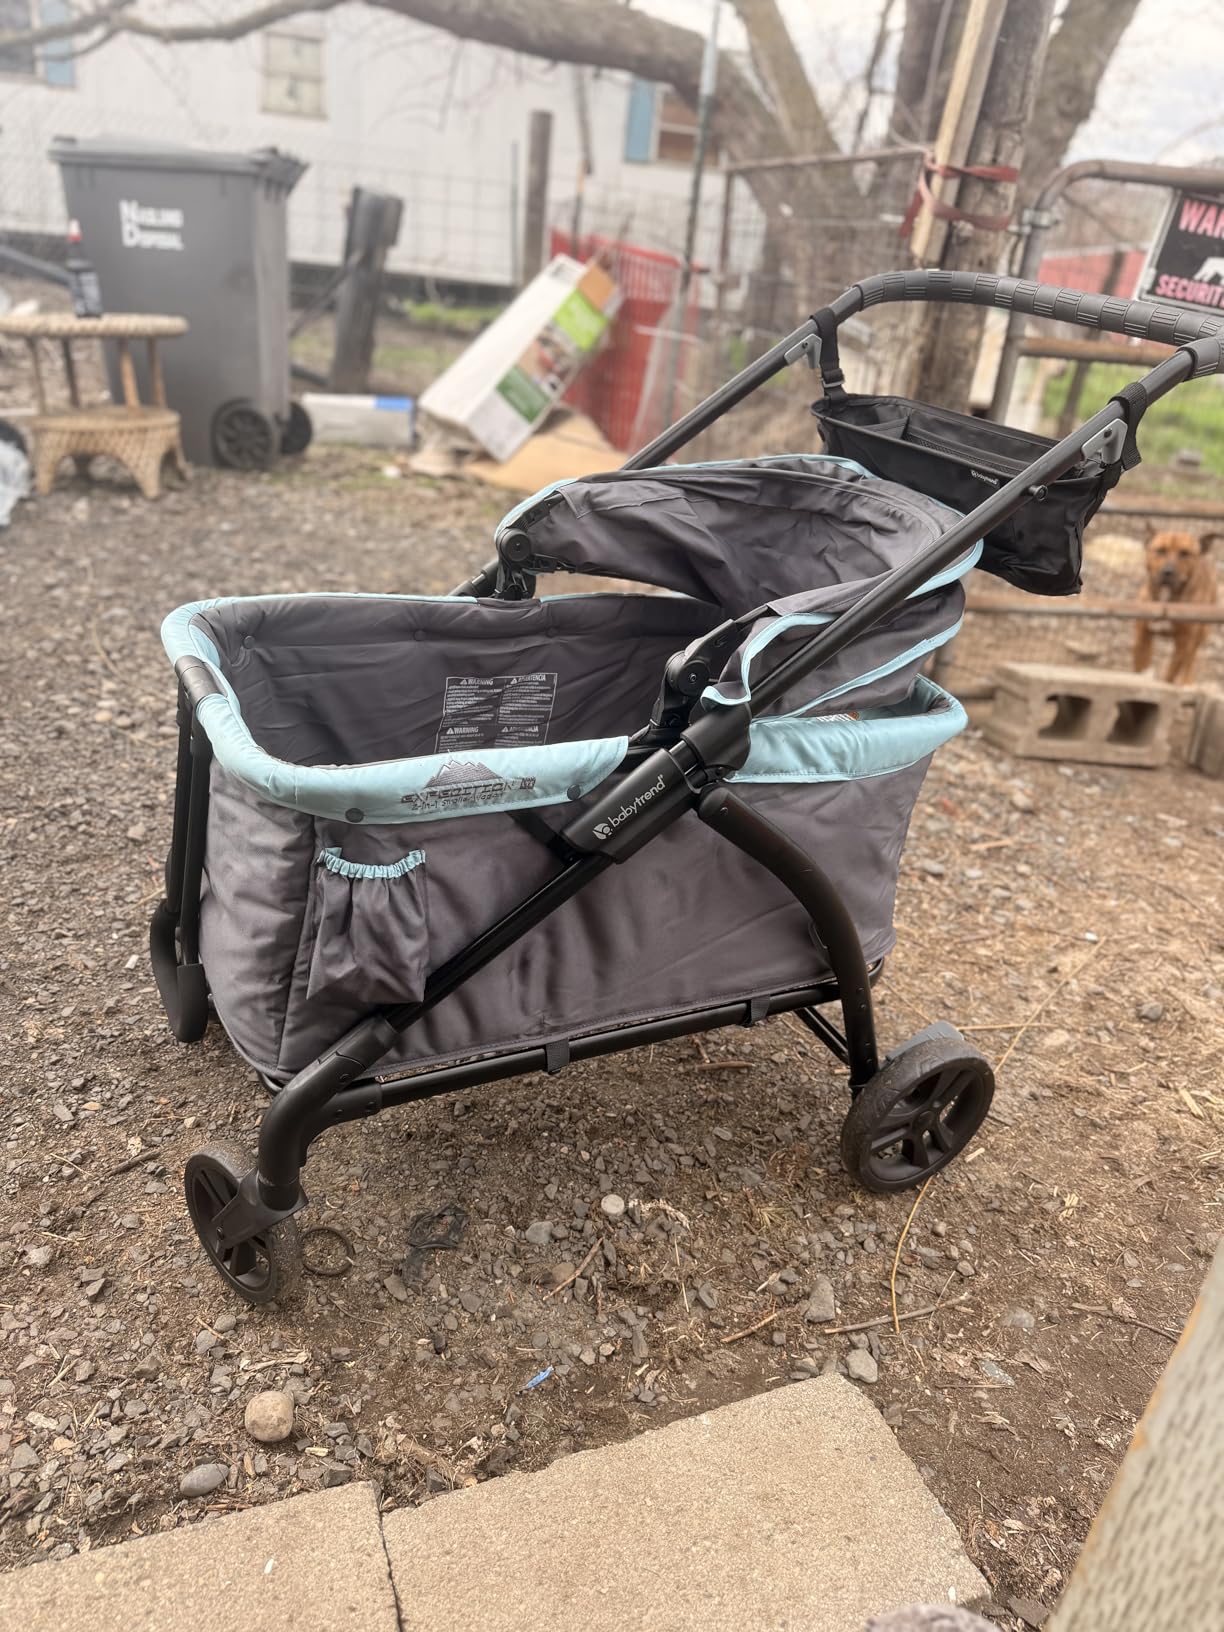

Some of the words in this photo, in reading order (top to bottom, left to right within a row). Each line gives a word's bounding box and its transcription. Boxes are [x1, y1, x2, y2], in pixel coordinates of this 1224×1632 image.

[1156, 273, 1224, 308] SECURIT
[453, 726, 479, 735] WARNING
[401, 779, 513, 804] EXPEDITION
[607, 774, 666, 828] babytrend
